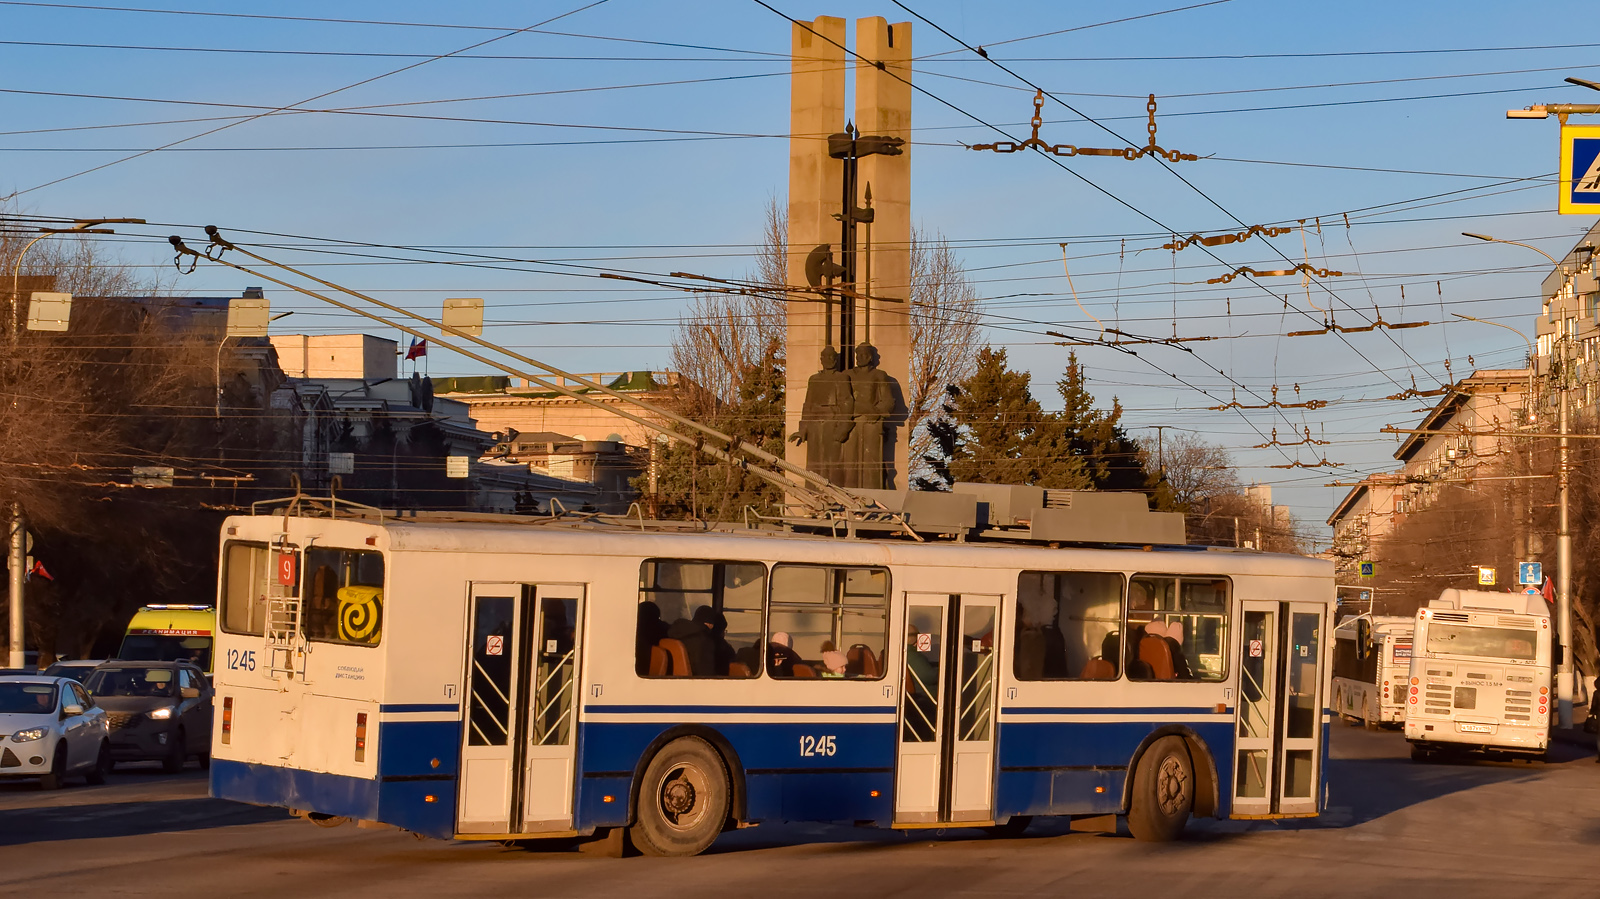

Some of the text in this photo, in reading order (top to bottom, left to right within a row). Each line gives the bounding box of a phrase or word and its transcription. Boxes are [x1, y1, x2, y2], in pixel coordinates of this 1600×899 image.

[283, 560, 291, 580] 9
[227, 648, 256, 671] 1245
[337, 665, 364, 673] СОБЛЮДАЙ
[335, 672, 366, 681] ДИСТАНЦИЮ
[799, 735, 836, 756] 1245
